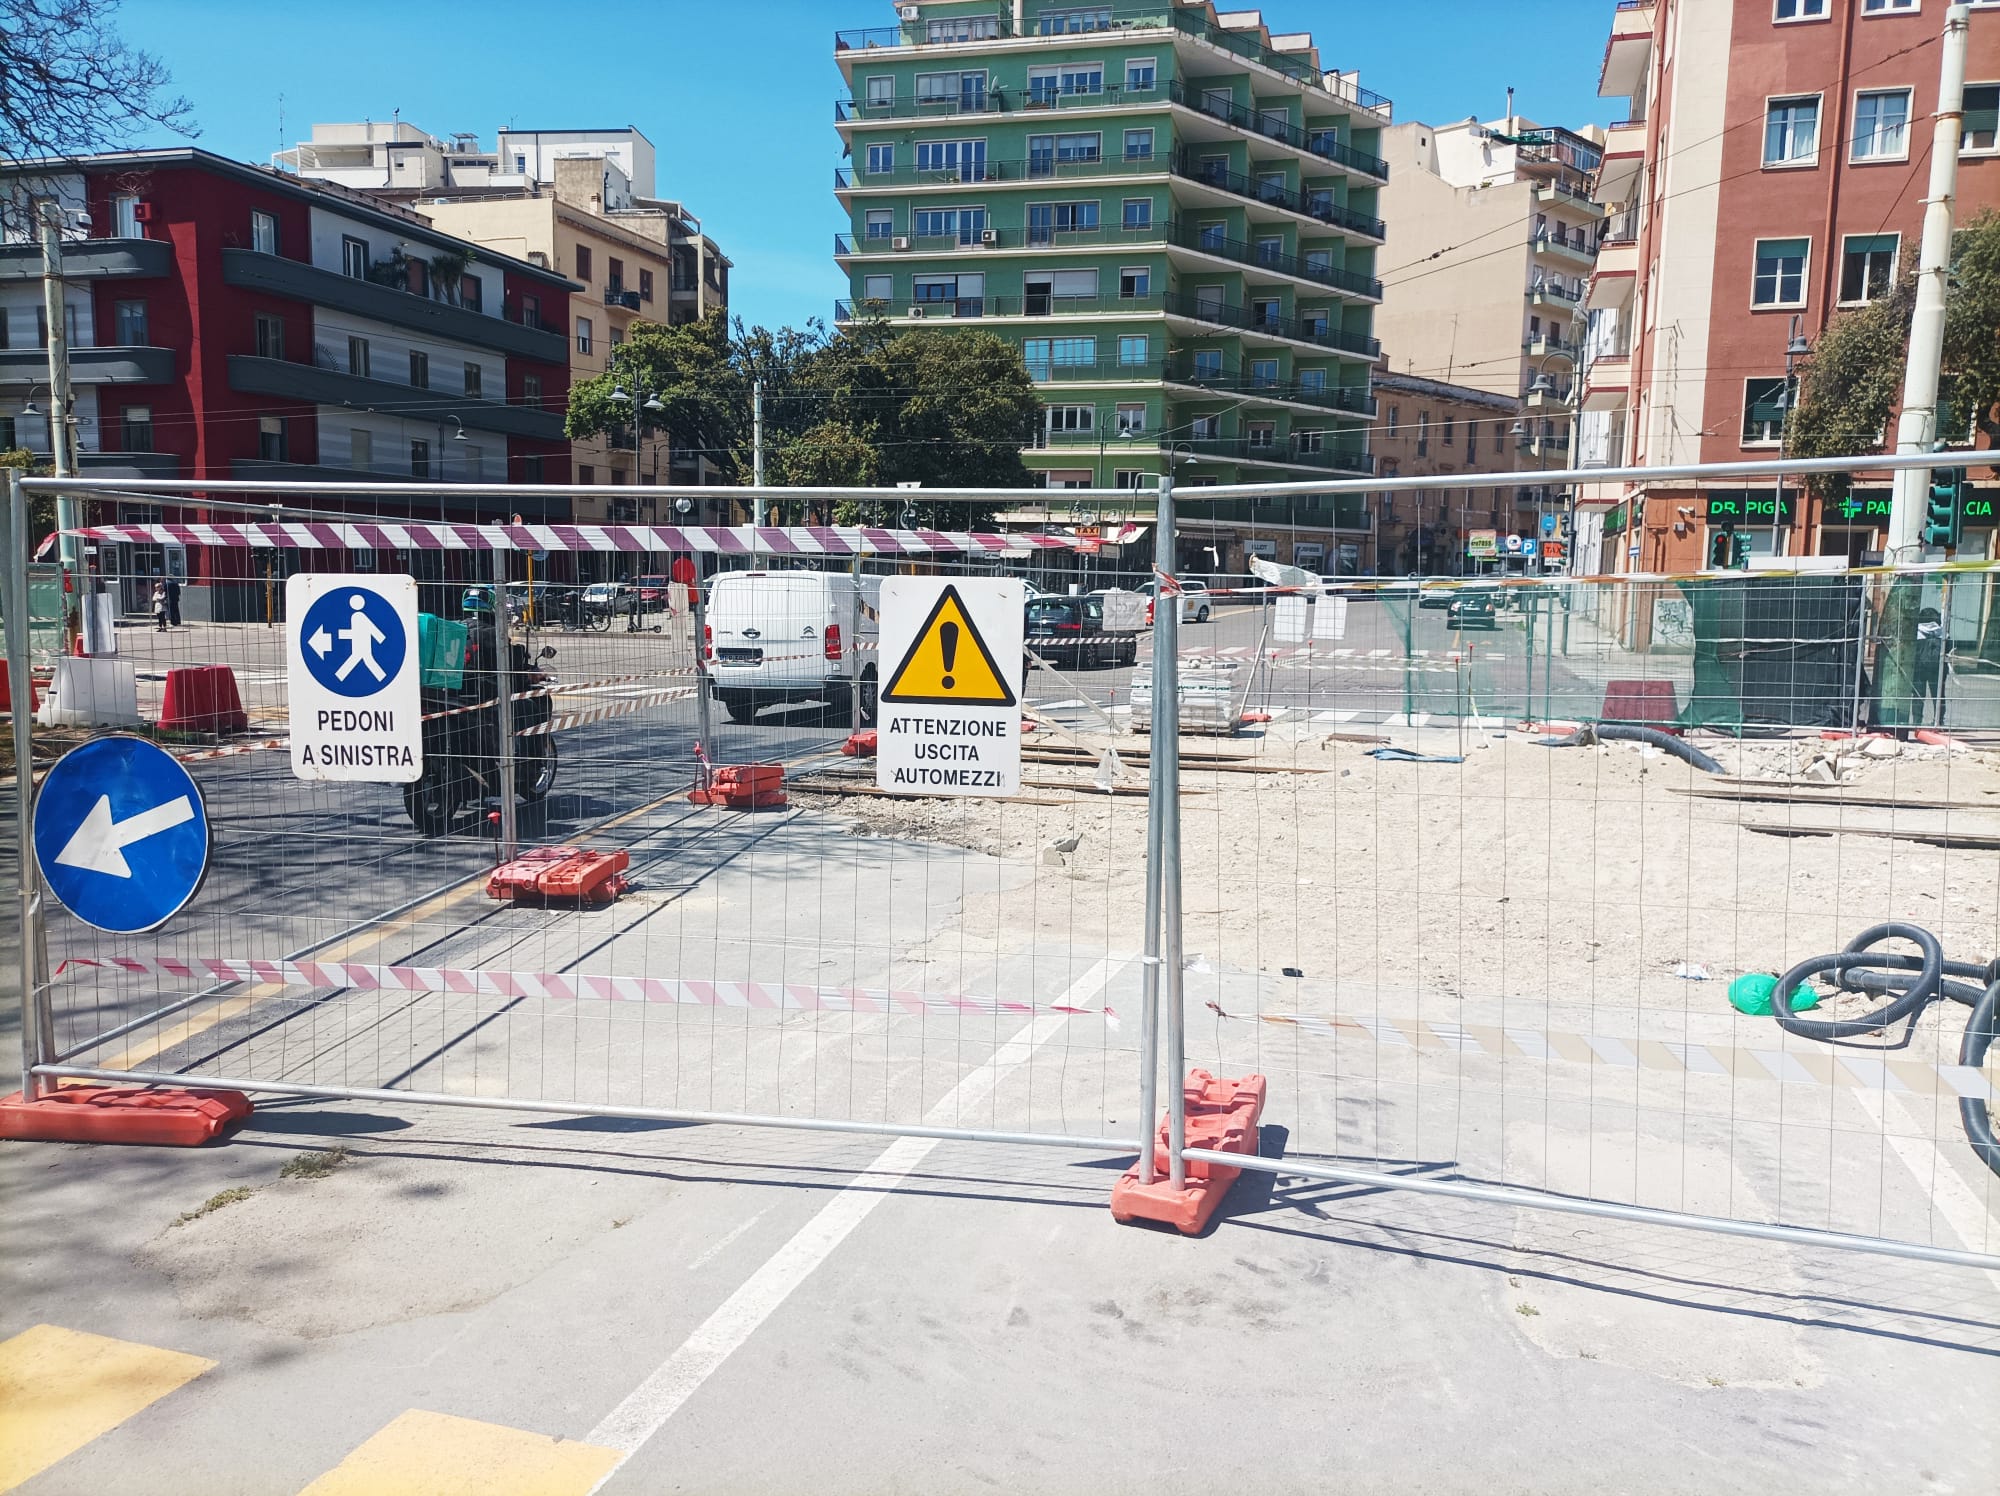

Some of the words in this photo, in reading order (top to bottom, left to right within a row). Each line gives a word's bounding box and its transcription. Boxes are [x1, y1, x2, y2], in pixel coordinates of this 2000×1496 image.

[1710, 501, 1740, 514] DR.
[318, 710, 394, 732] PEDONI
[890, 718, 1007, 737] ATTENZIONE
[302, 744, 315, 765] A
[321, 744, 414, 767] SINISTRA
[915, 743, 980, 761] USCITA
[894, 767, 1001, 787] AUTOMEZZI
